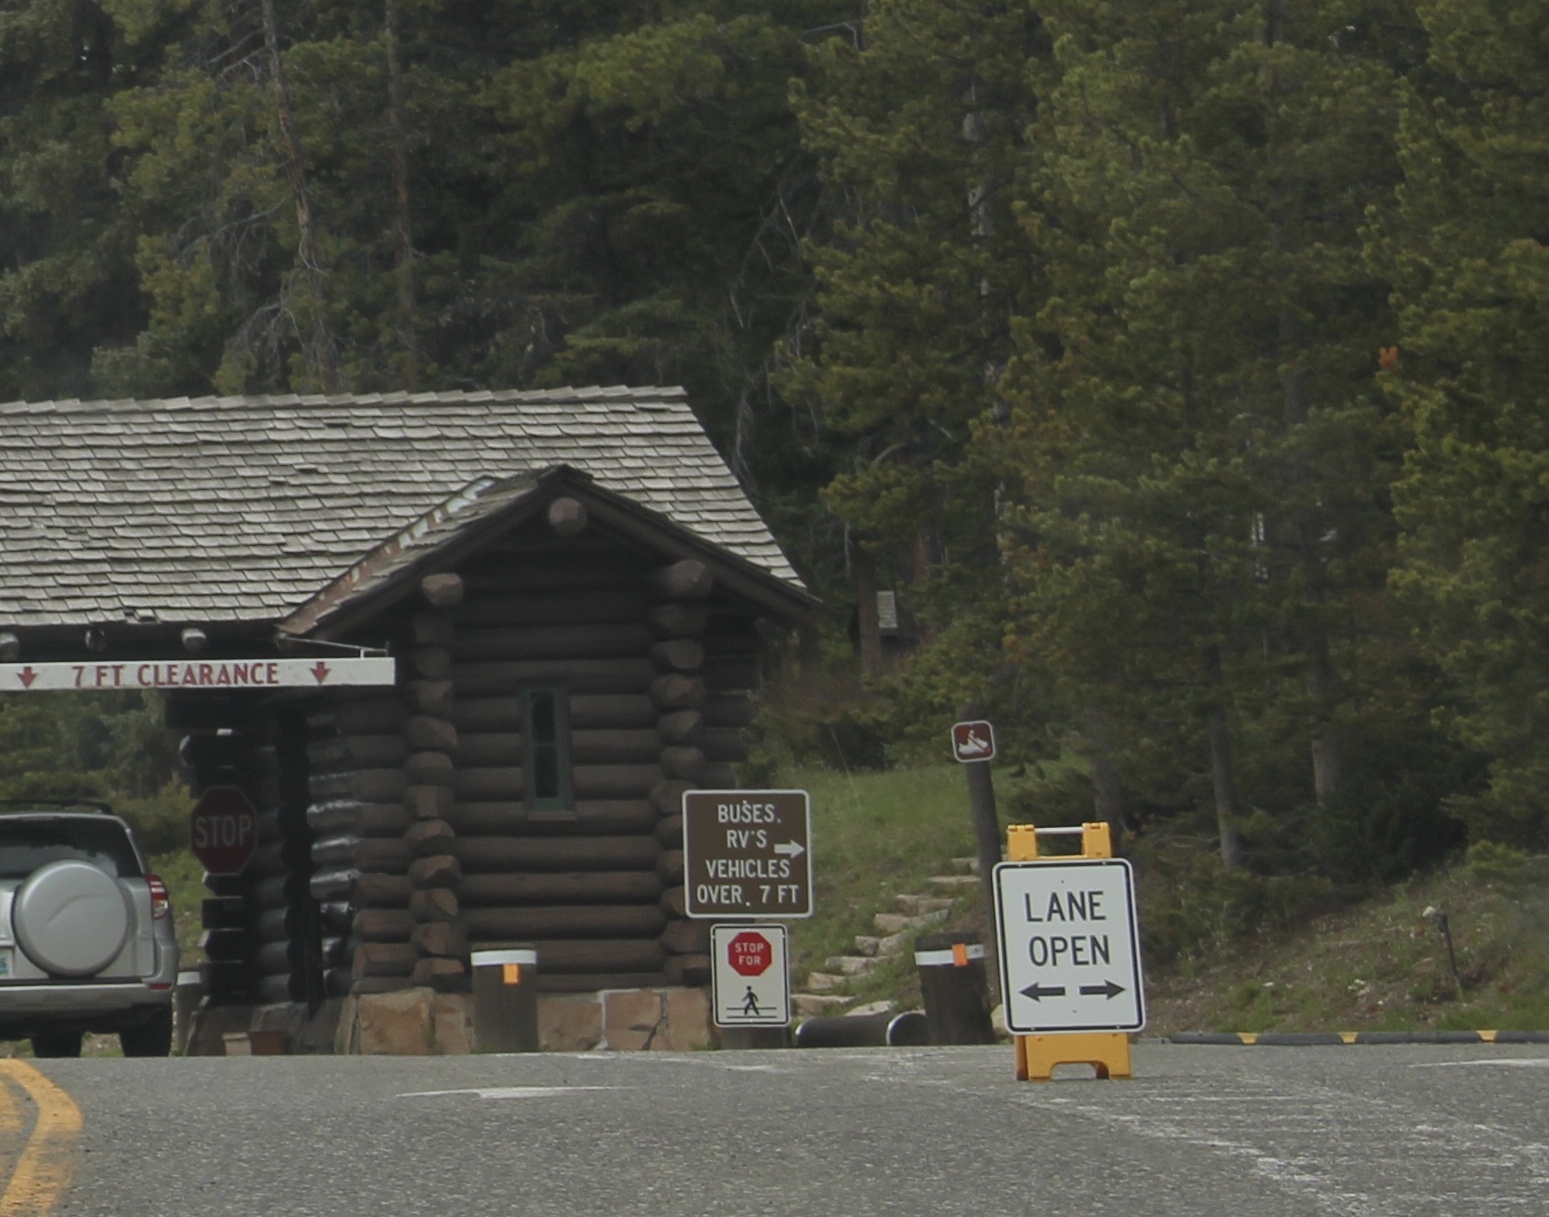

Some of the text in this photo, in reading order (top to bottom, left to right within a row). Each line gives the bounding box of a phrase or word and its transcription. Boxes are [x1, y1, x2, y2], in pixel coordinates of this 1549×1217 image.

[72, 663, 279, 688] 7 FT CLEARANCE
[195, 814, 252, 848] STOP
[727, 829, 767, 849] RV'S
[705, 859, 790, 878] VEHICLES
[697, 884, 799, 904] OVER 7 FT
[1024, 890, 1106, 922] LANE
[735, 942, 764, 953] STOP
[1029, 934, 1110, 967] OPEN
[738, 955, 761, 966] FOR
